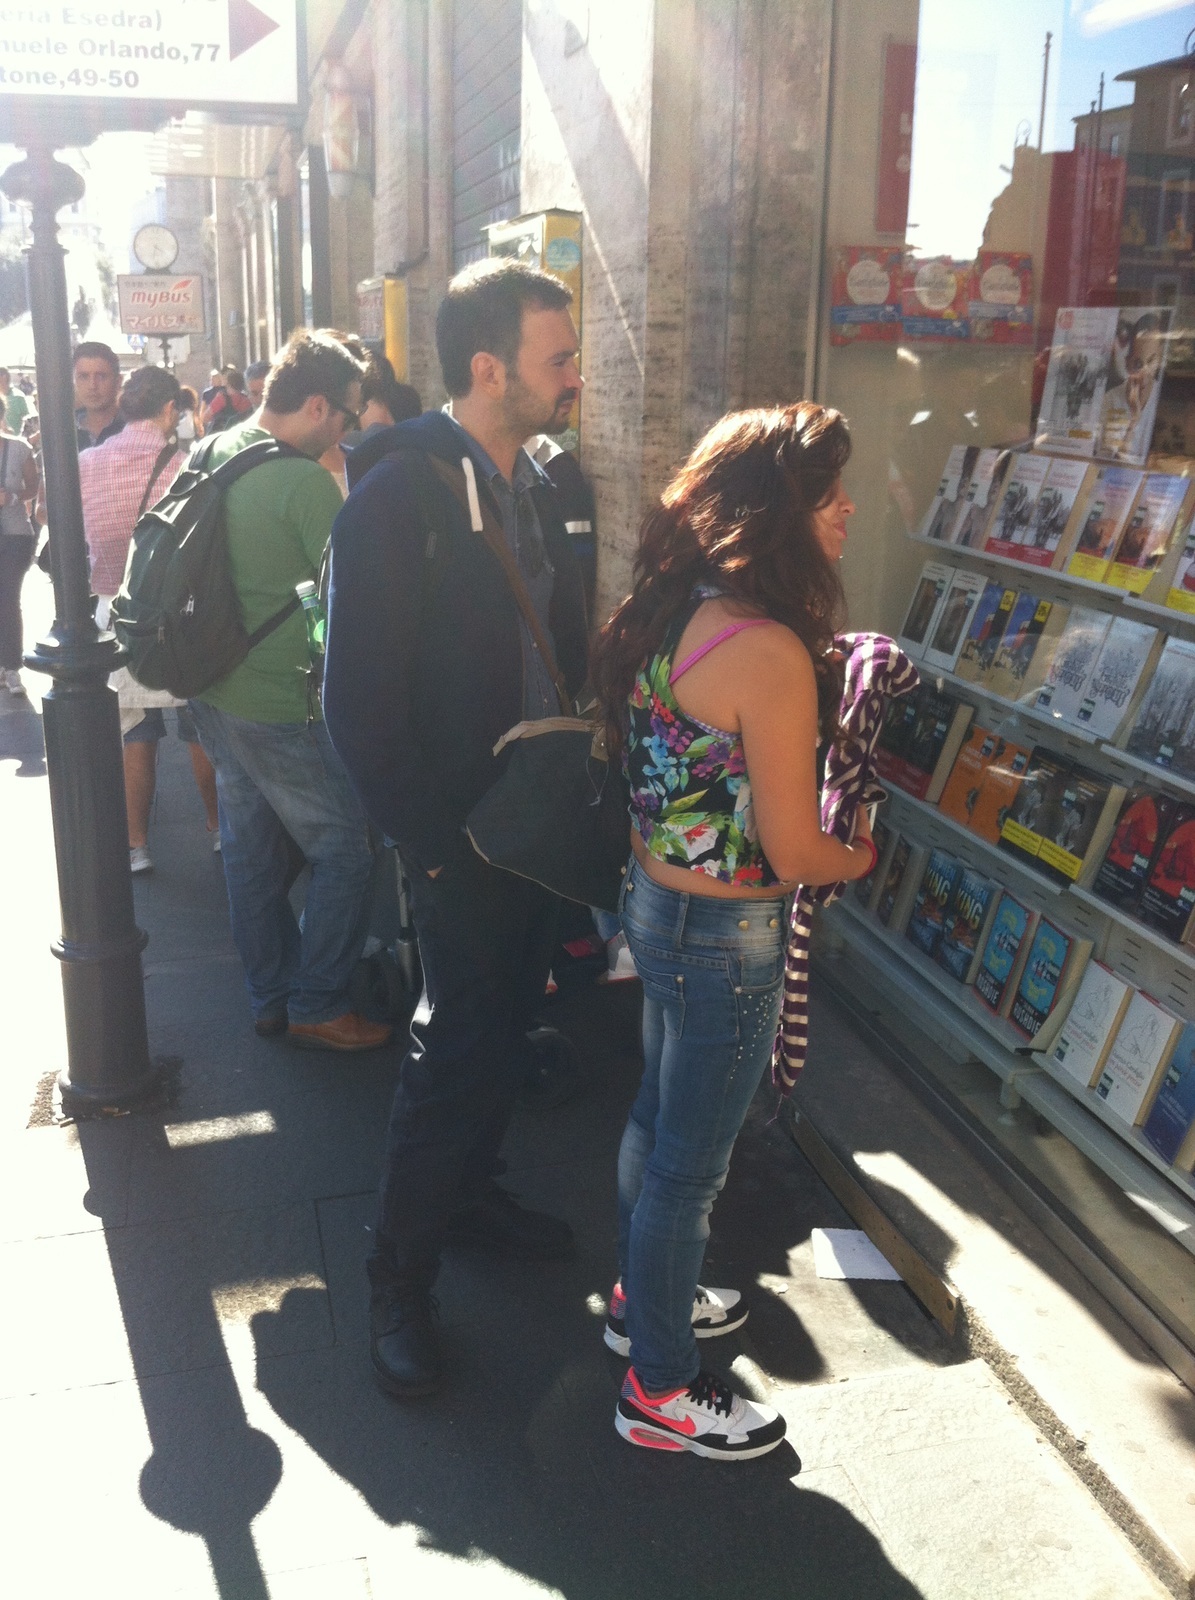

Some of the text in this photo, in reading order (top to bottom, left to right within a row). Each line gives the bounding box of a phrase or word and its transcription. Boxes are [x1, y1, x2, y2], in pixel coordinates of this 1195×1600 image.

[61, 7, 163, 31] Esedra)
[78, 38, 221, 64] Orlando,77
[955, 888, 983, 930] KING
